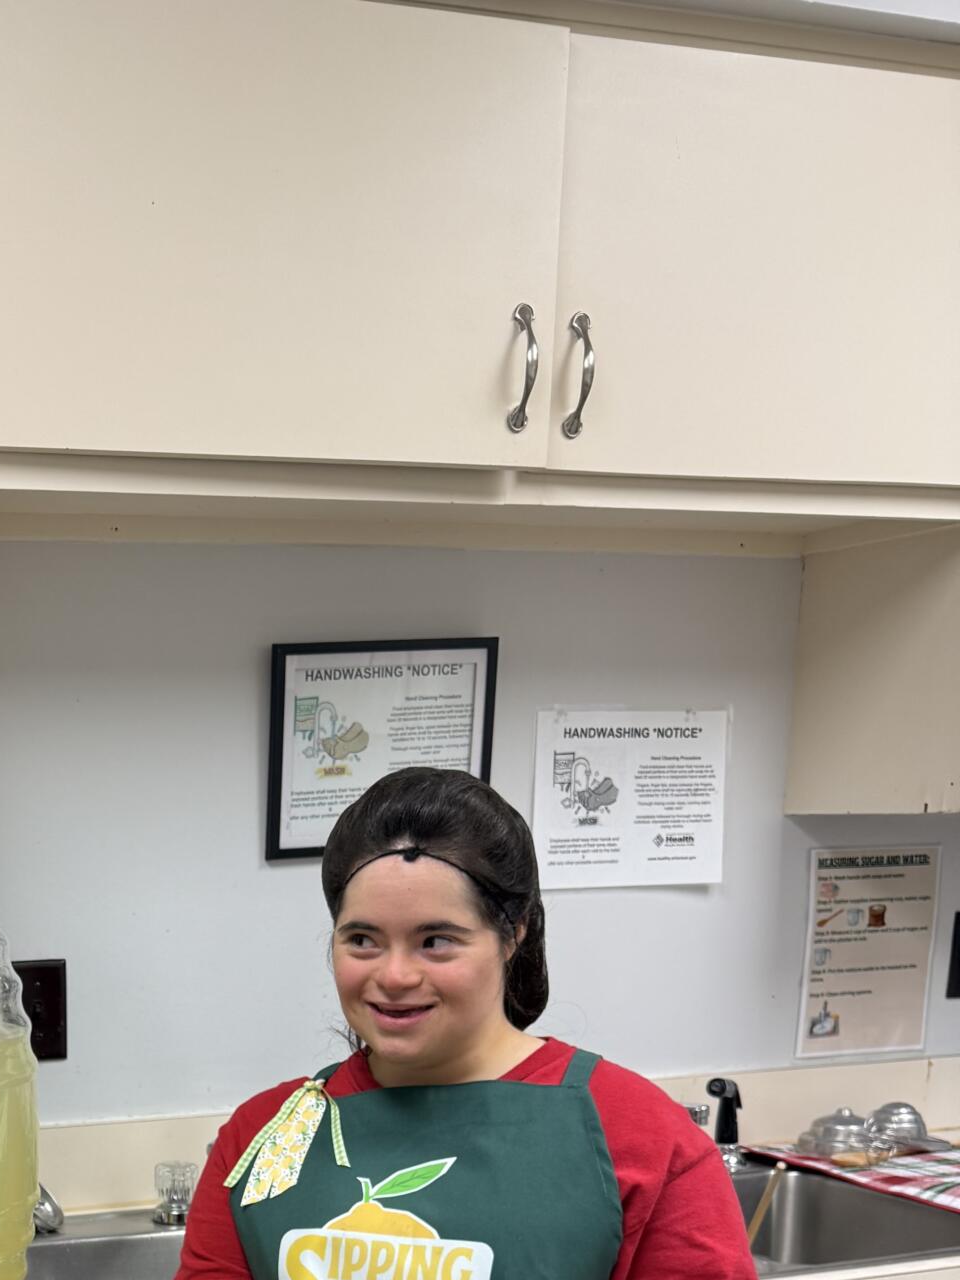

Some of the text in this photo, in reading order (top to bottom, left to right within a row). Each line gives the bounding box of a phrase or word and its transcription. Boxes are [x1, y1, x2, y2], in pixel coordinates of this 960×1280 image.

[304, 667, 404, 682] HANDWASHING
[563, 727, 650, 739] HANDWASHING
[664, 835, 695, 843] Health
